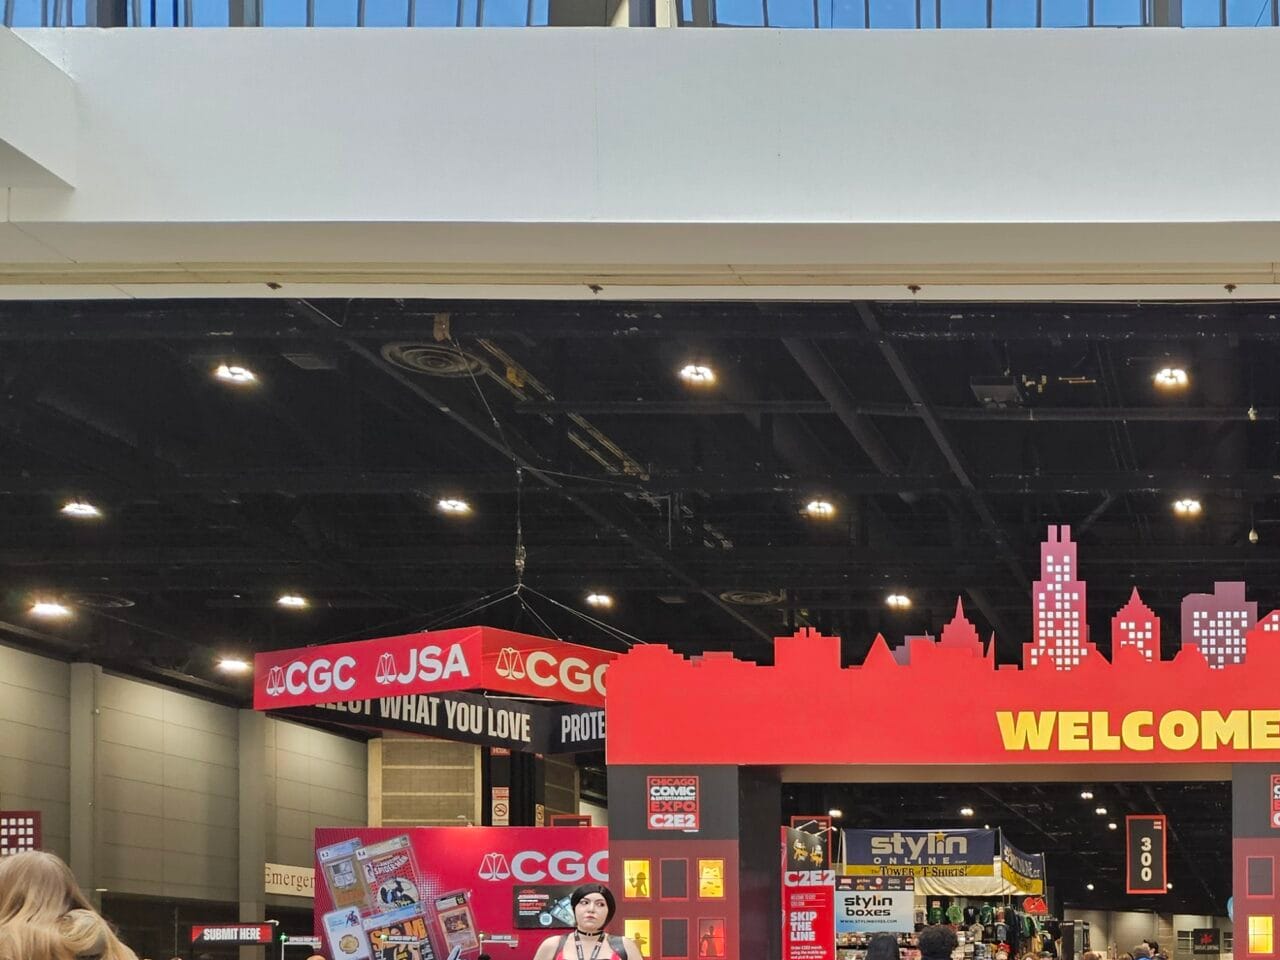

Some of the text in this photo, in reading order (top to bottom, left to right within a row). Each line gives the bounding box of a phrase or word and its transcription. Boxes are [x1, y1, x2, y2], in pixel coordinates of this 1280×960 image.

[285, 643, 471, 696] CGC JSA
[379, 694, 440, 727] WHAT
[443, 699, 483, 734] YOU
[487, 708, 532, 743] LOVE
[650, 786, 696, 796] COMIC
[650, 801, 696, 812] EXPO
[650, 813, 696, 827] C2E2
[870, 832, 968, 861] stylin
[873, 857, 950, 865] ONLINE
[1140, 836, 1153, 882] 300
[510, 850, 609, 883] CGC
[783, 869, 836, 888] C2E2
[844, 895, 893, 909] stylin
[790, 911, 818, 921] SKIP
[845, 907, 891, 917] boxes
[790, 921, 812, 931] THE
[203, 927, 261, 941] SUBMIT HERE
[790, 931, 816, 942] LINE
